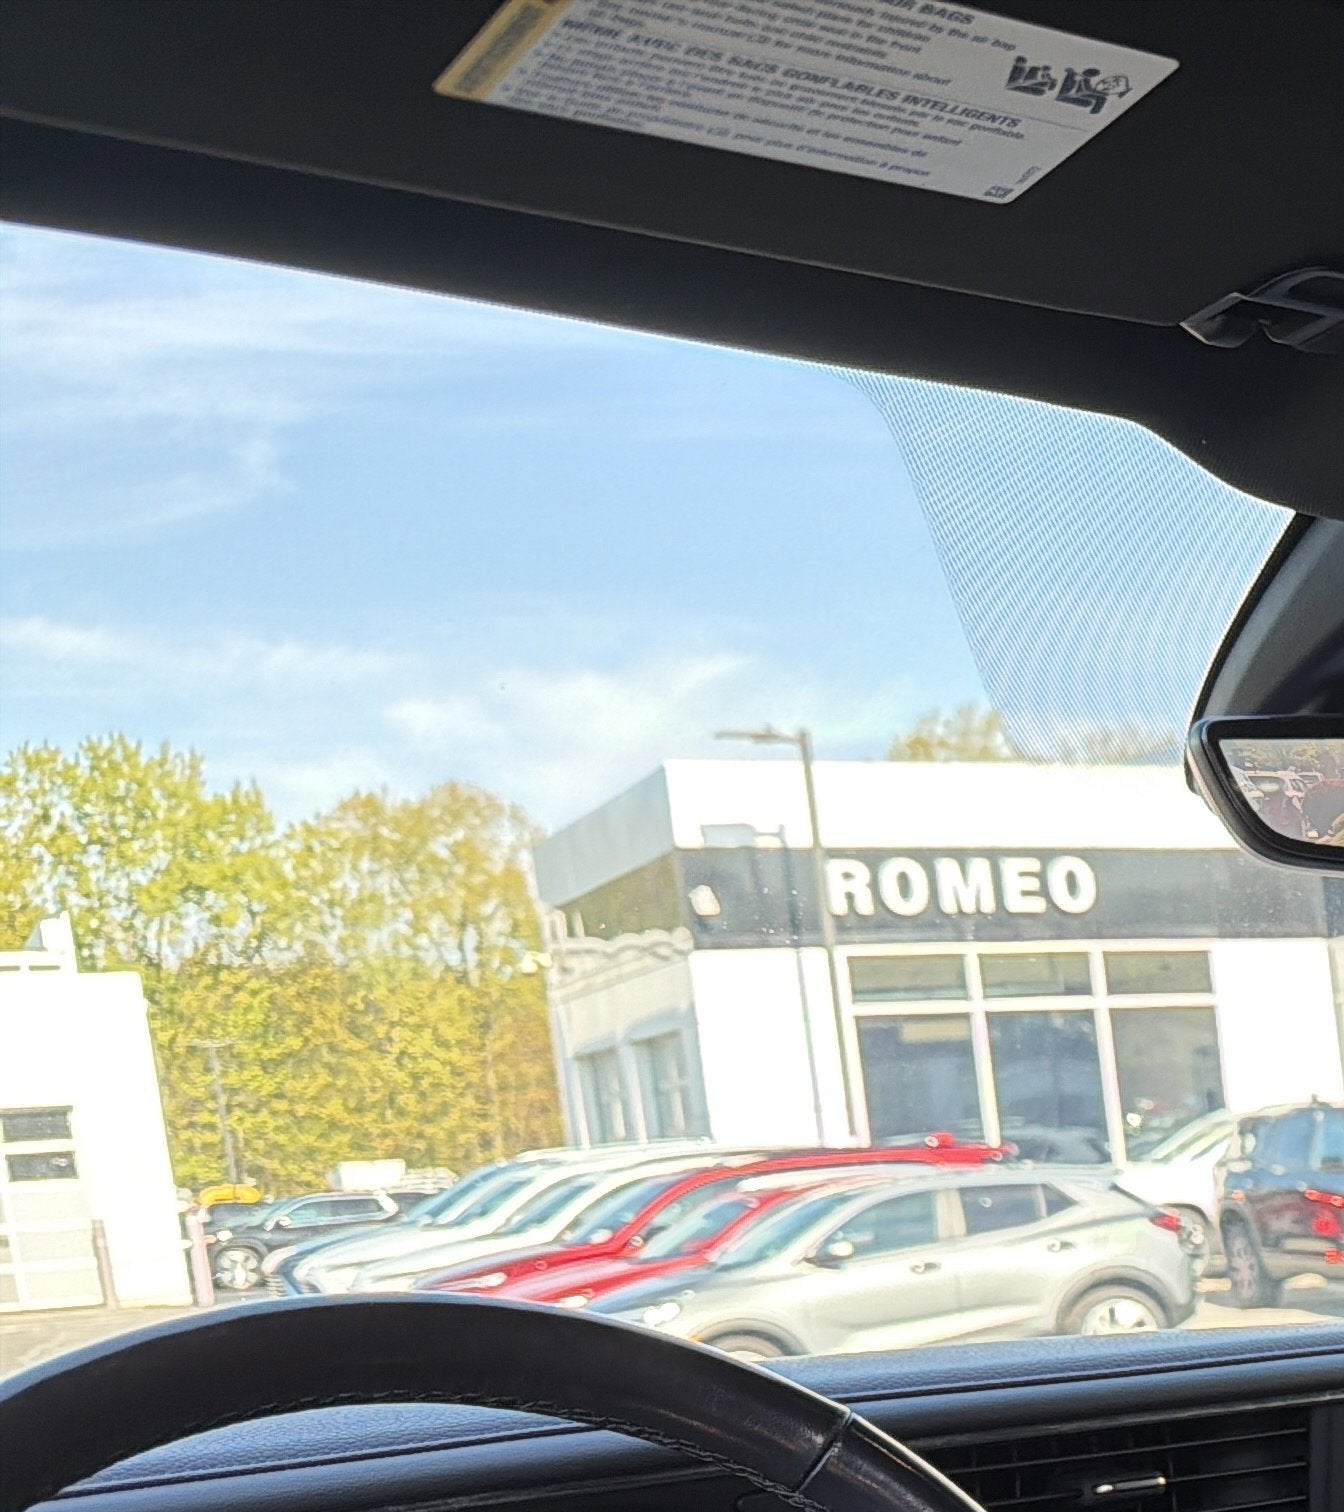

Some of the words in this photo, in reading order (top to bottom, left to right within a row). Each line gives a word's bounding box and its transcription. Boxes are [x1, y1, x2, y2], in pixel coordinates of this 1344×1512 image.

[917, 2, 977, 24] BAGS
[782, 67, 900, 101] GONFLABLES
[900, 94, 1021, 128] INTELLIGENTS
[824, 855, 1098, 917] ROMEO
